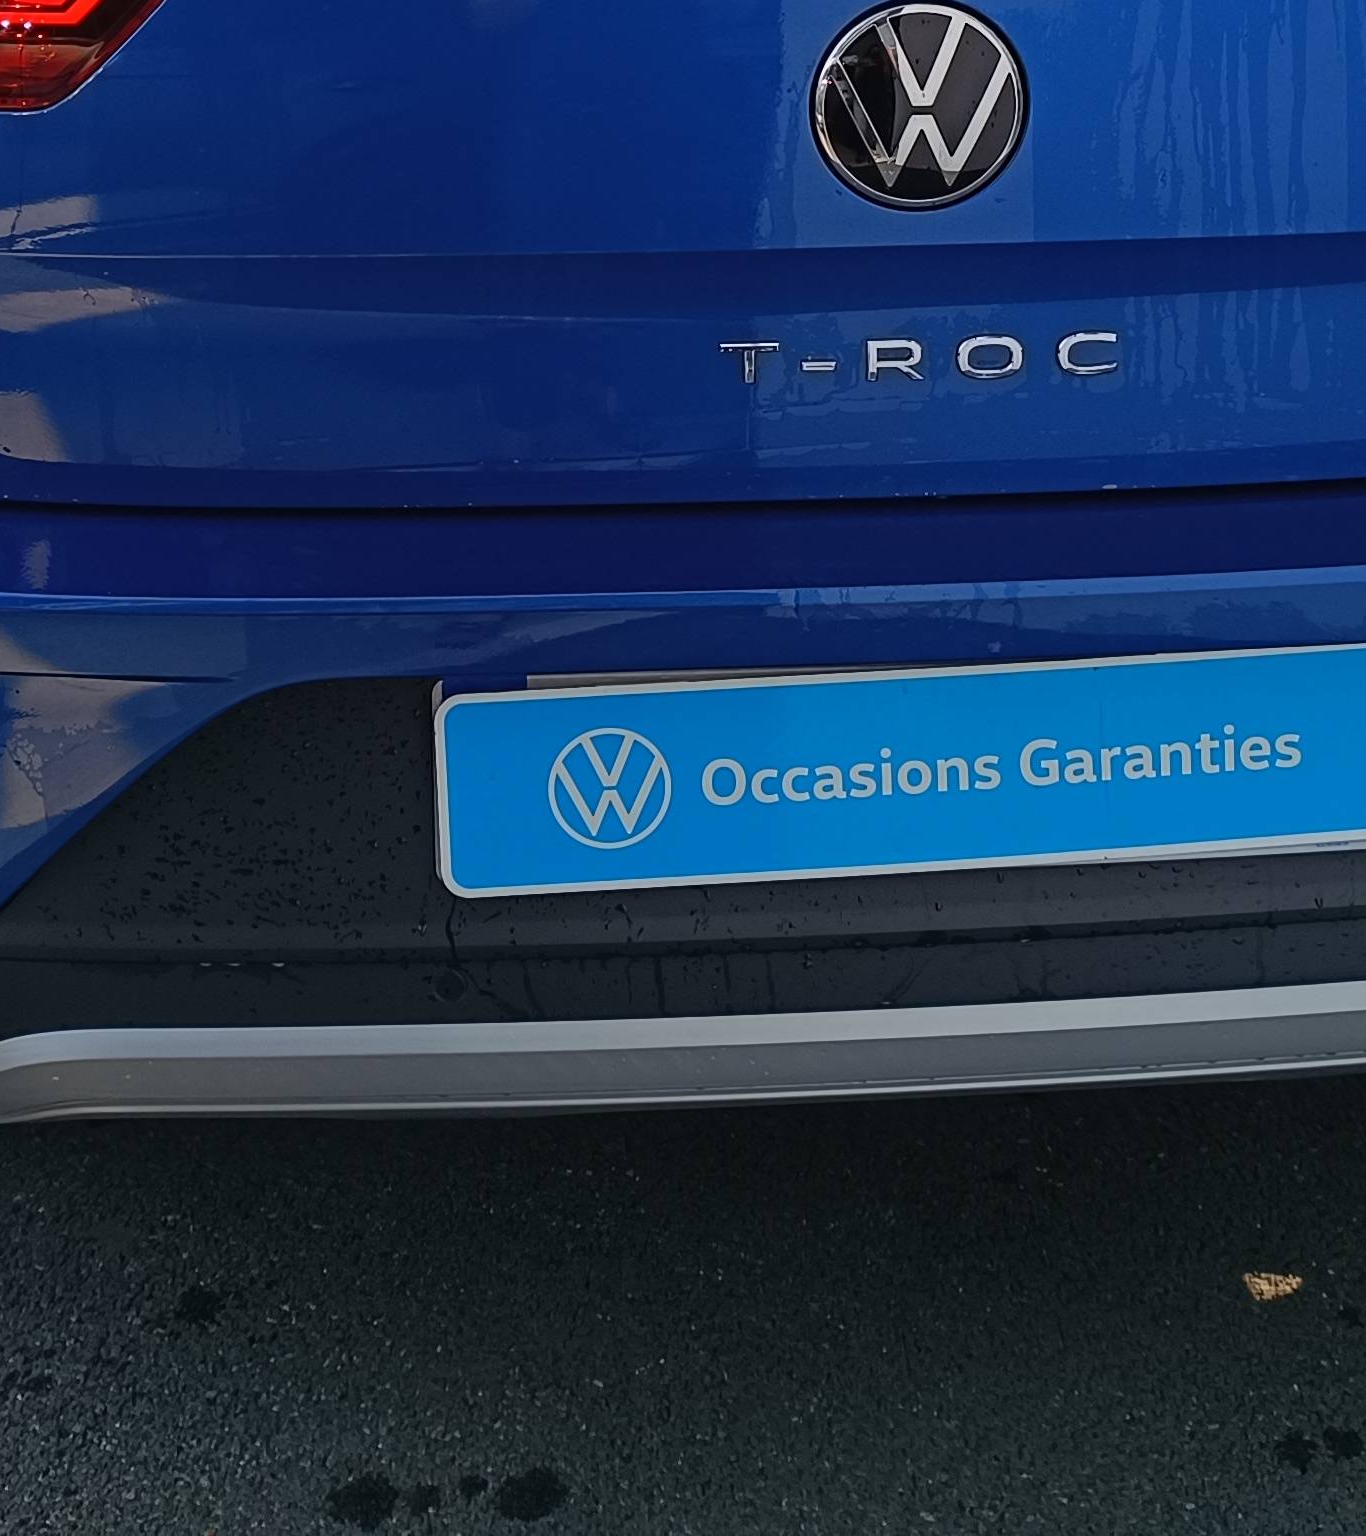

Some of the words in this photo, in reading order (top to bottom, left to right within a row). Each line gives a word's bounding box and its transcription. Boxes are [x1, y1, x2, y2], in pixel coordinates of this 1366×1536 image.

[814, 3, 1025, 206] VW
[719, 331, 1119, 385] T-ROC
[547, 727, 672, 850] VW
[701, 746, 1002, 807] Occasions
[1018, 723, 1303, 787] Garanties
